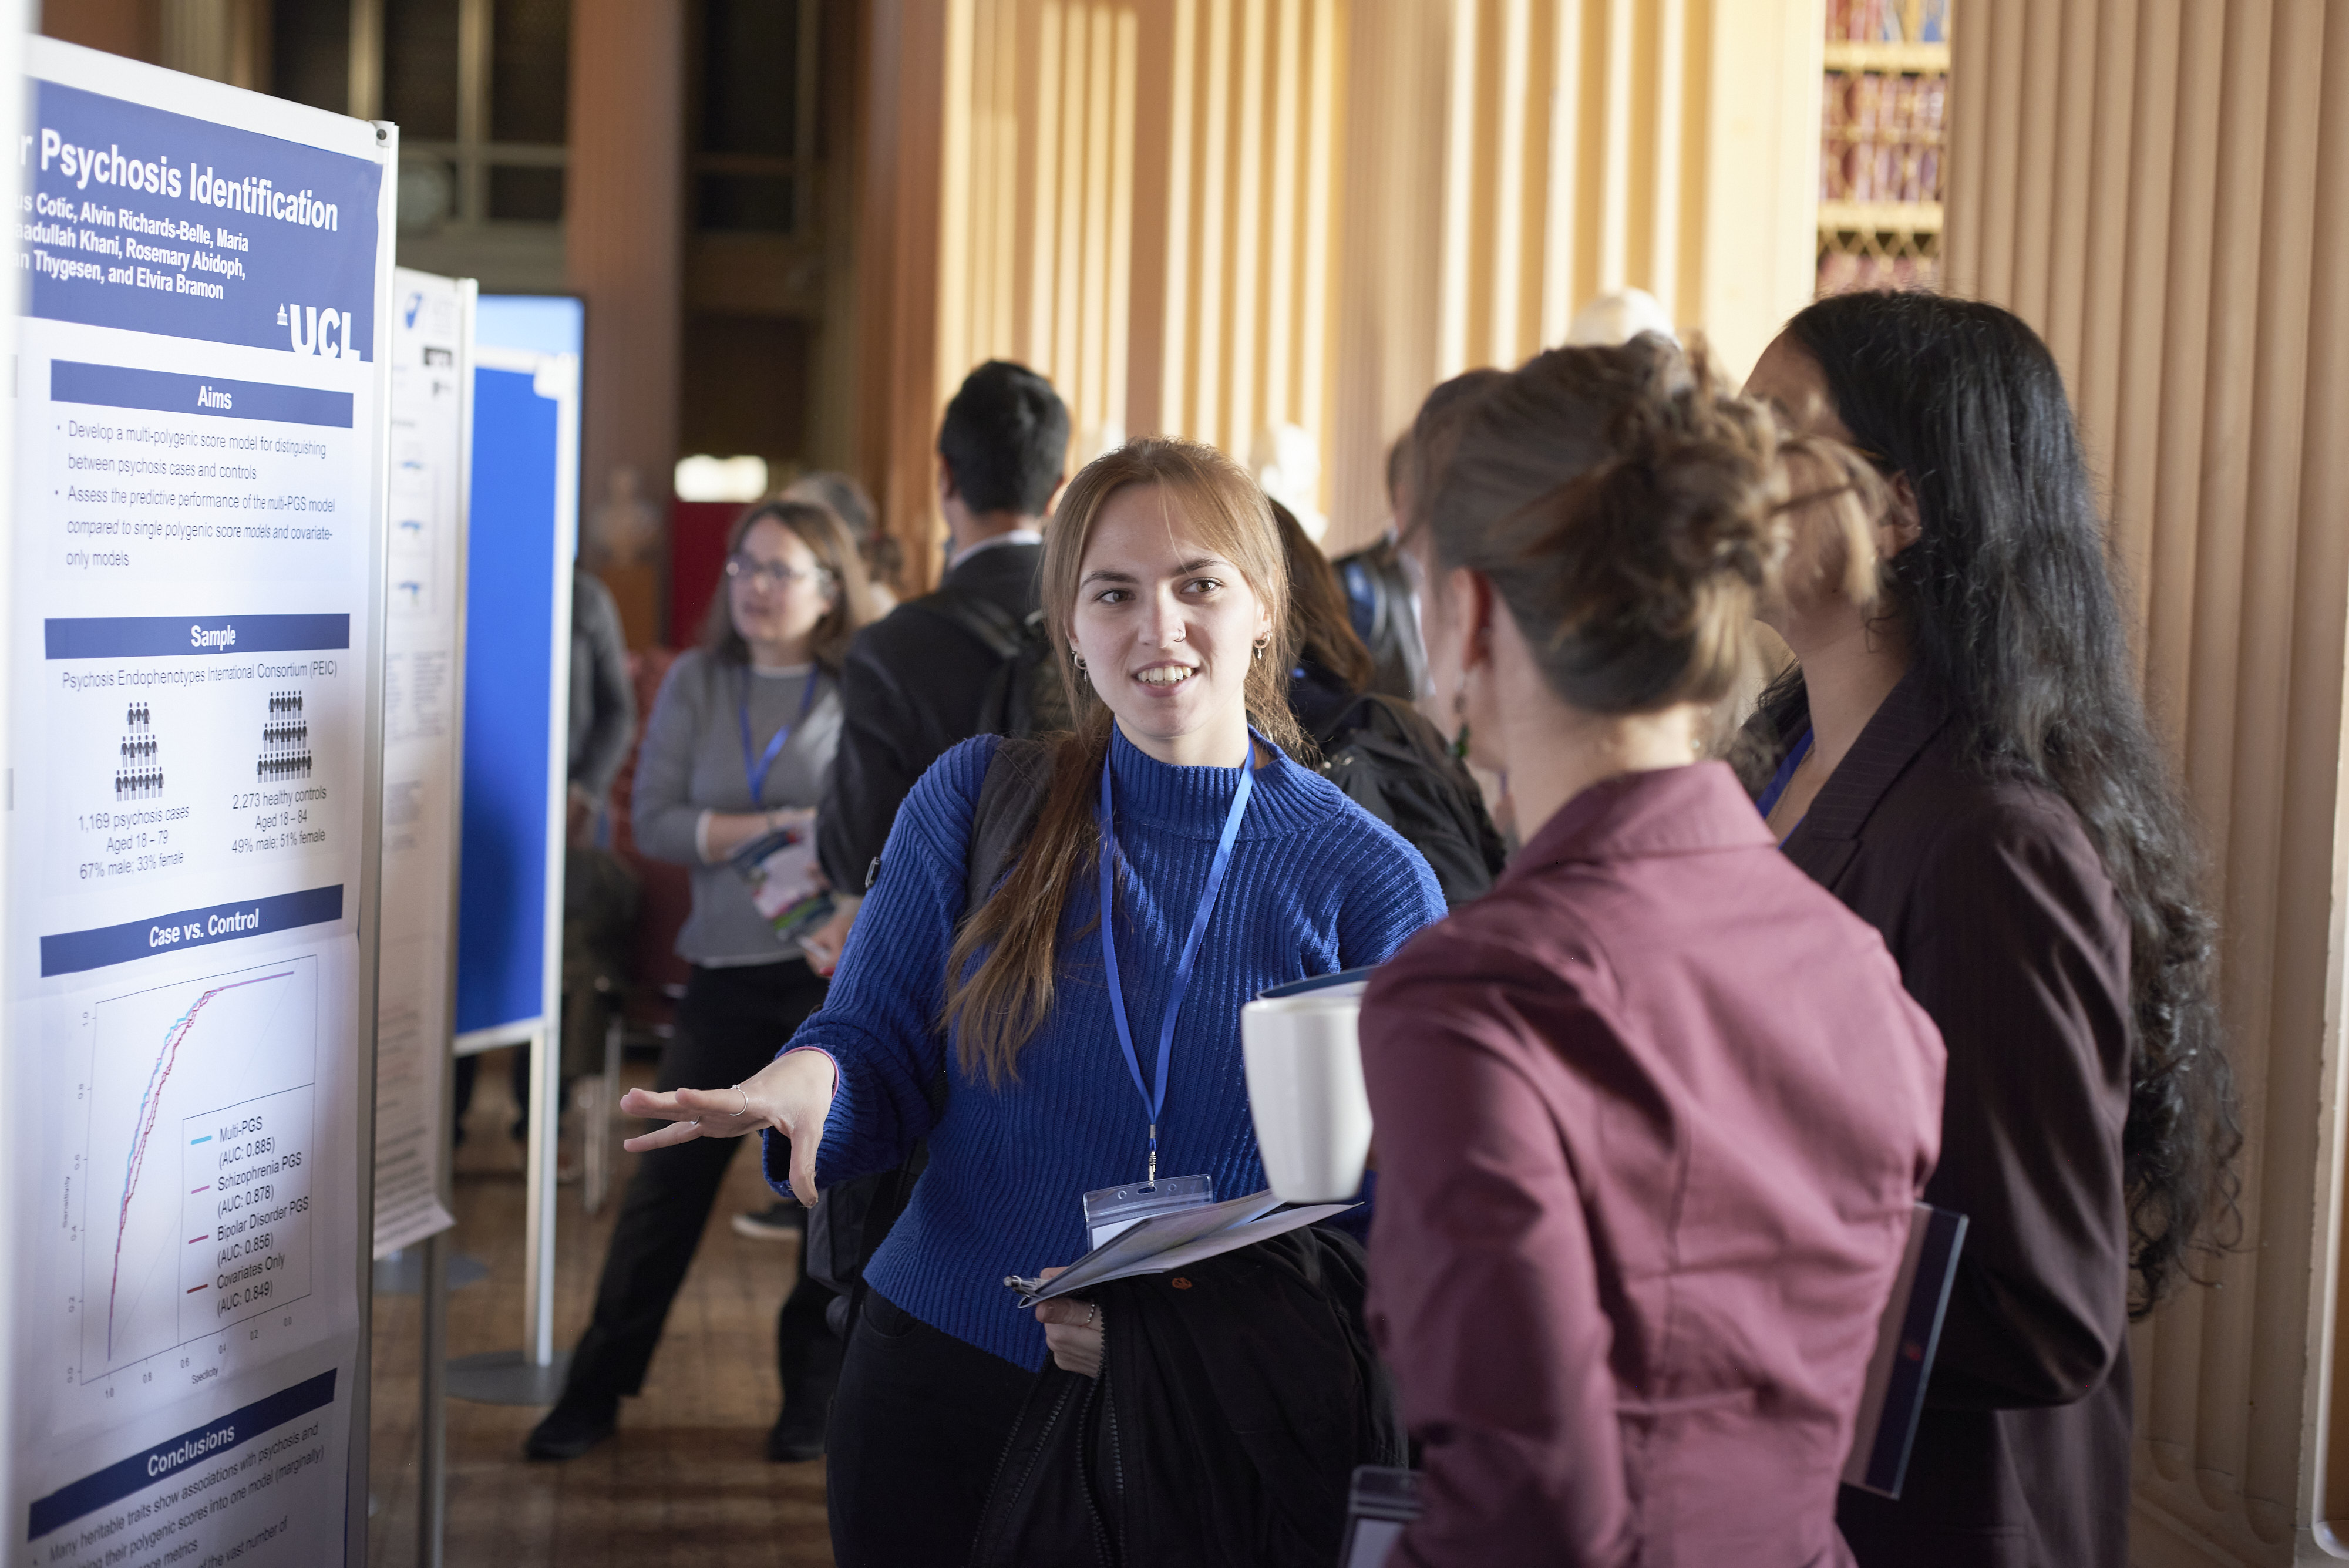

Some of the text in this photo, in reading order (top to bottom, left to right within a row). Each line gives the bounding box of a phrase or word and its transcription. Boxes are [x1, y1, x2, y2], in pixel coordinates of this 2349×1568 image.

[41, 127, 182, 198] Psychosis
[190, 163, 338, 231] Identification
[36, 193, 78, 224] Cotic,
[80, 201, 116, 227] Alvin
[119, 208, 214, 248] Richards-Belle,
[217, 228, 249, 252] Maria
[79, 229, 123, 260] Khani,
[126, 237, 190, 272] Rosemary
[192, 250, 245, 281] Abidoph,
[33, 249, 105, 285] Thygesen,
[108, 266, 134, 285] and
[136, 267, 173, 292] Elvira
[176, 274, 224, 300] Bramon
[290, 304, 361, 361] UCL
[197, 385, 233, 409] Aims
[69, 420, 326, 459] Develop a multi-polygenic score model for distinguishing
[68, 453, 257, 479] between psychosis cases and controls
[68, 485, 335, 512] Assess the predictive performance of the multi-PGS model
[67, 519, 119, 538] compared
[122, 520, 132, 534] to
[134, 520, 162, 539] single
[165, 521, 213, 540] polygenic
[216, 526, 241, 538] score
[243, 524, 271, 539] models
[273, 524, 289, 539] and
[66, 550, 129, 570] only models
[191, 625, 236, 651] Sample
[63, 671, 114, 692] Psychosis
[118, 668, 206, 689] Endophenotypes
[208, 664, 254, 681] International
[257, 662, 307, 678] Consortium
[263, 790, 293, 807] healthy
[295, 785, 327, 803] controls
[78, 806, 190, 833] 1,169 psychosis cases
[255, 813, 277, 832] Aged
[280, 812, 288, 825] 18
[106, 835, 133, 854] Aged
[136, 833, 147, 848] 18
[299, 829, 325, 845] female
[80, 862, 105, 879] 67%
[159, 850, 184, 867] female
[149, 908, 259, 948] Case vs. Control
[219, 1116, 263, 1143] Multi-PGS
[218, 1136, 275, 1170] (AUC: 0.885)
[218, 1152, 301, 1191] Schizophrenia PGS
[217, 1195, 243, 1219] (AUC:
[217, 1196, 309, 1242] Bipolar Disorder PGS
[217, 1244, 243, 1268] (AUC:
[217, 1253, 285, 1290] Covariates Only
[217, 1293, 243, 1318] (AUC:
[191, 1367, 218, 1385] Specificity
[148, 1425, 235, 1477] Conclusions
[50, 1539, 78, 1563] Many
[127, 1504, 152, 1526] traits
[154, 1490, 179, 1513] show
[181, 1462, 238, 1499] associations
[240, 1452, 257, 1472] with
[258, 1431, 300, 1466] psychosis
[302, 1421, 319, 1441] and
[130, 1520, 176, 1557] polygenic
[178, 1505, 208, 1530] scores
[209, 1496, 228, 1515] into
[230, 1486, 247, 1505] one
[248, 1469, 274, 1496] model
[226, 1540, 244, 1561] vast
[246, 1525, 278, 1552] number
[279, 1515, 288, 1532] of
[164, 1539, 198, 1567] metrics
